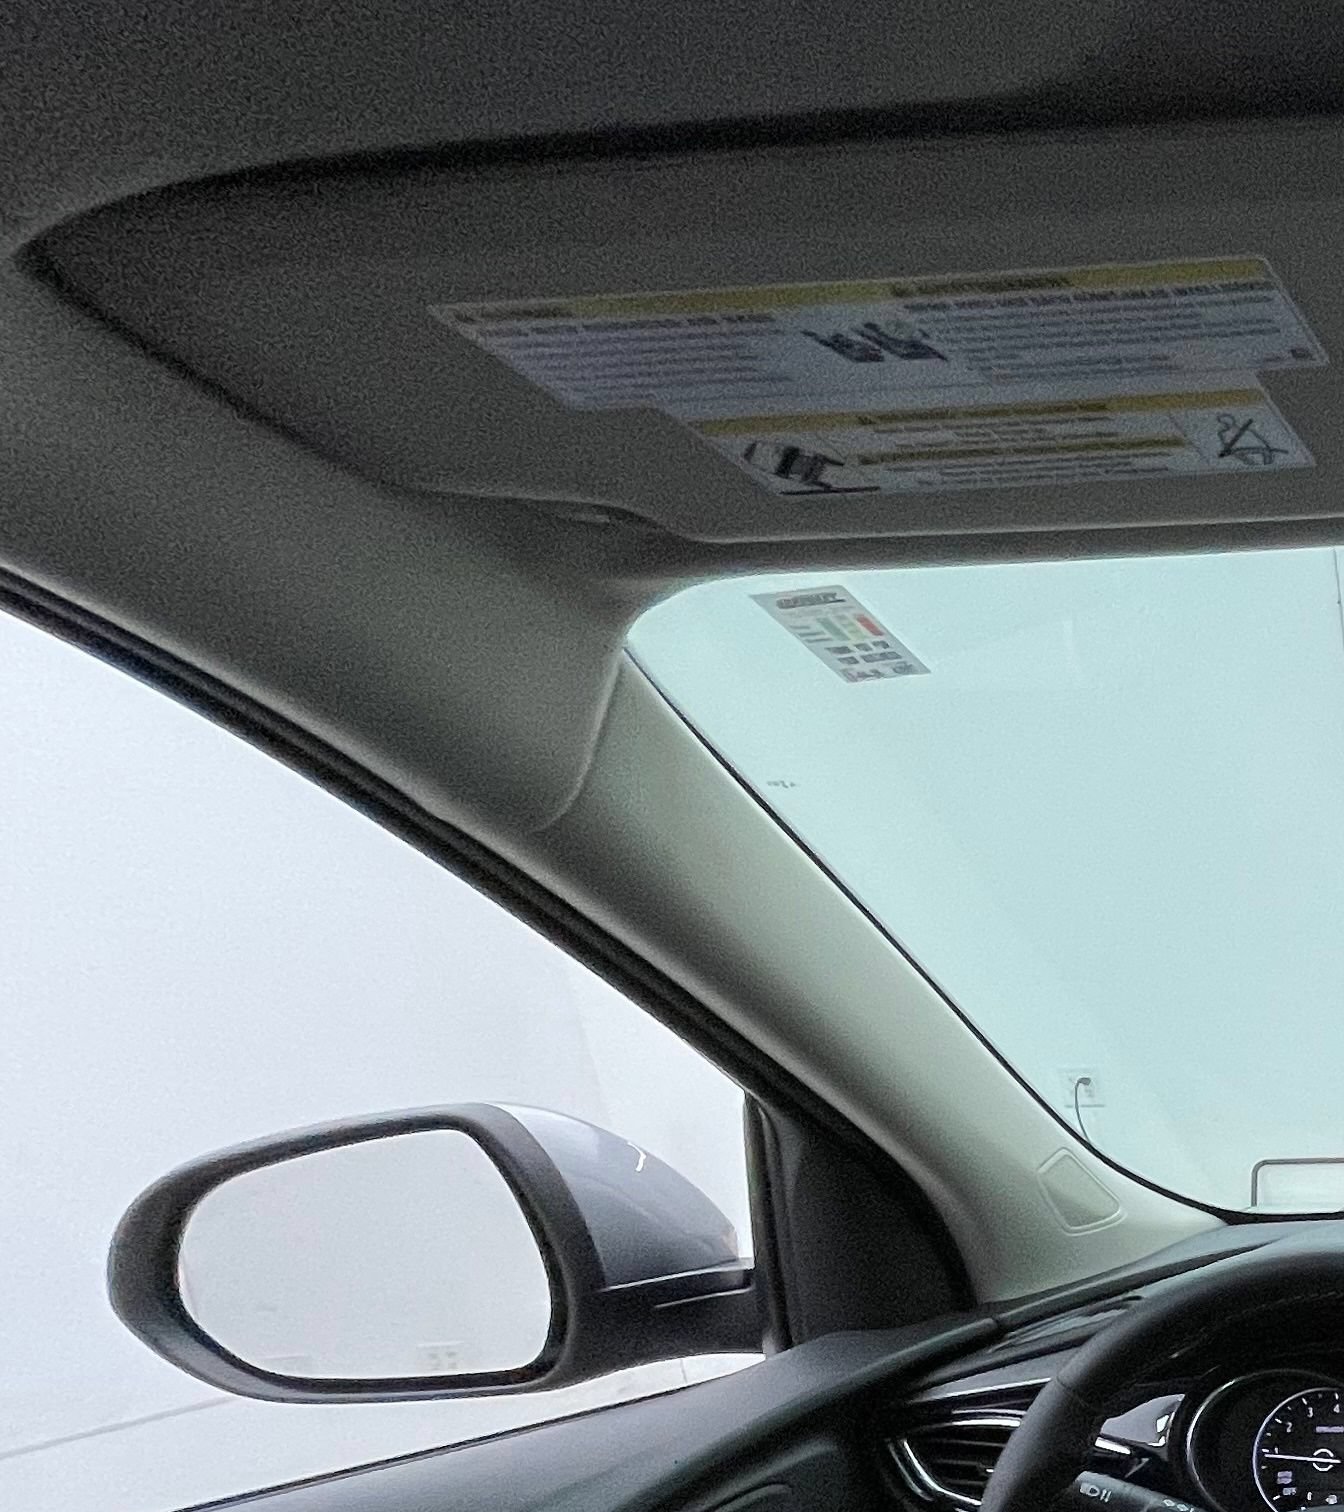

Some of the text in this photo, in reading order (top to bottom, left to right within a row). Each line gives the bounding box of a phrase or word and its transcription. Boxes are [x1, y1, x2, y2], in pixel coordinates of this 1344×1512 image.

[1307, 1407, 1314, 1418] 3
[1333, 1404, 1340, 1414] 4
[1286, 1422, 1293, 1433] 2
